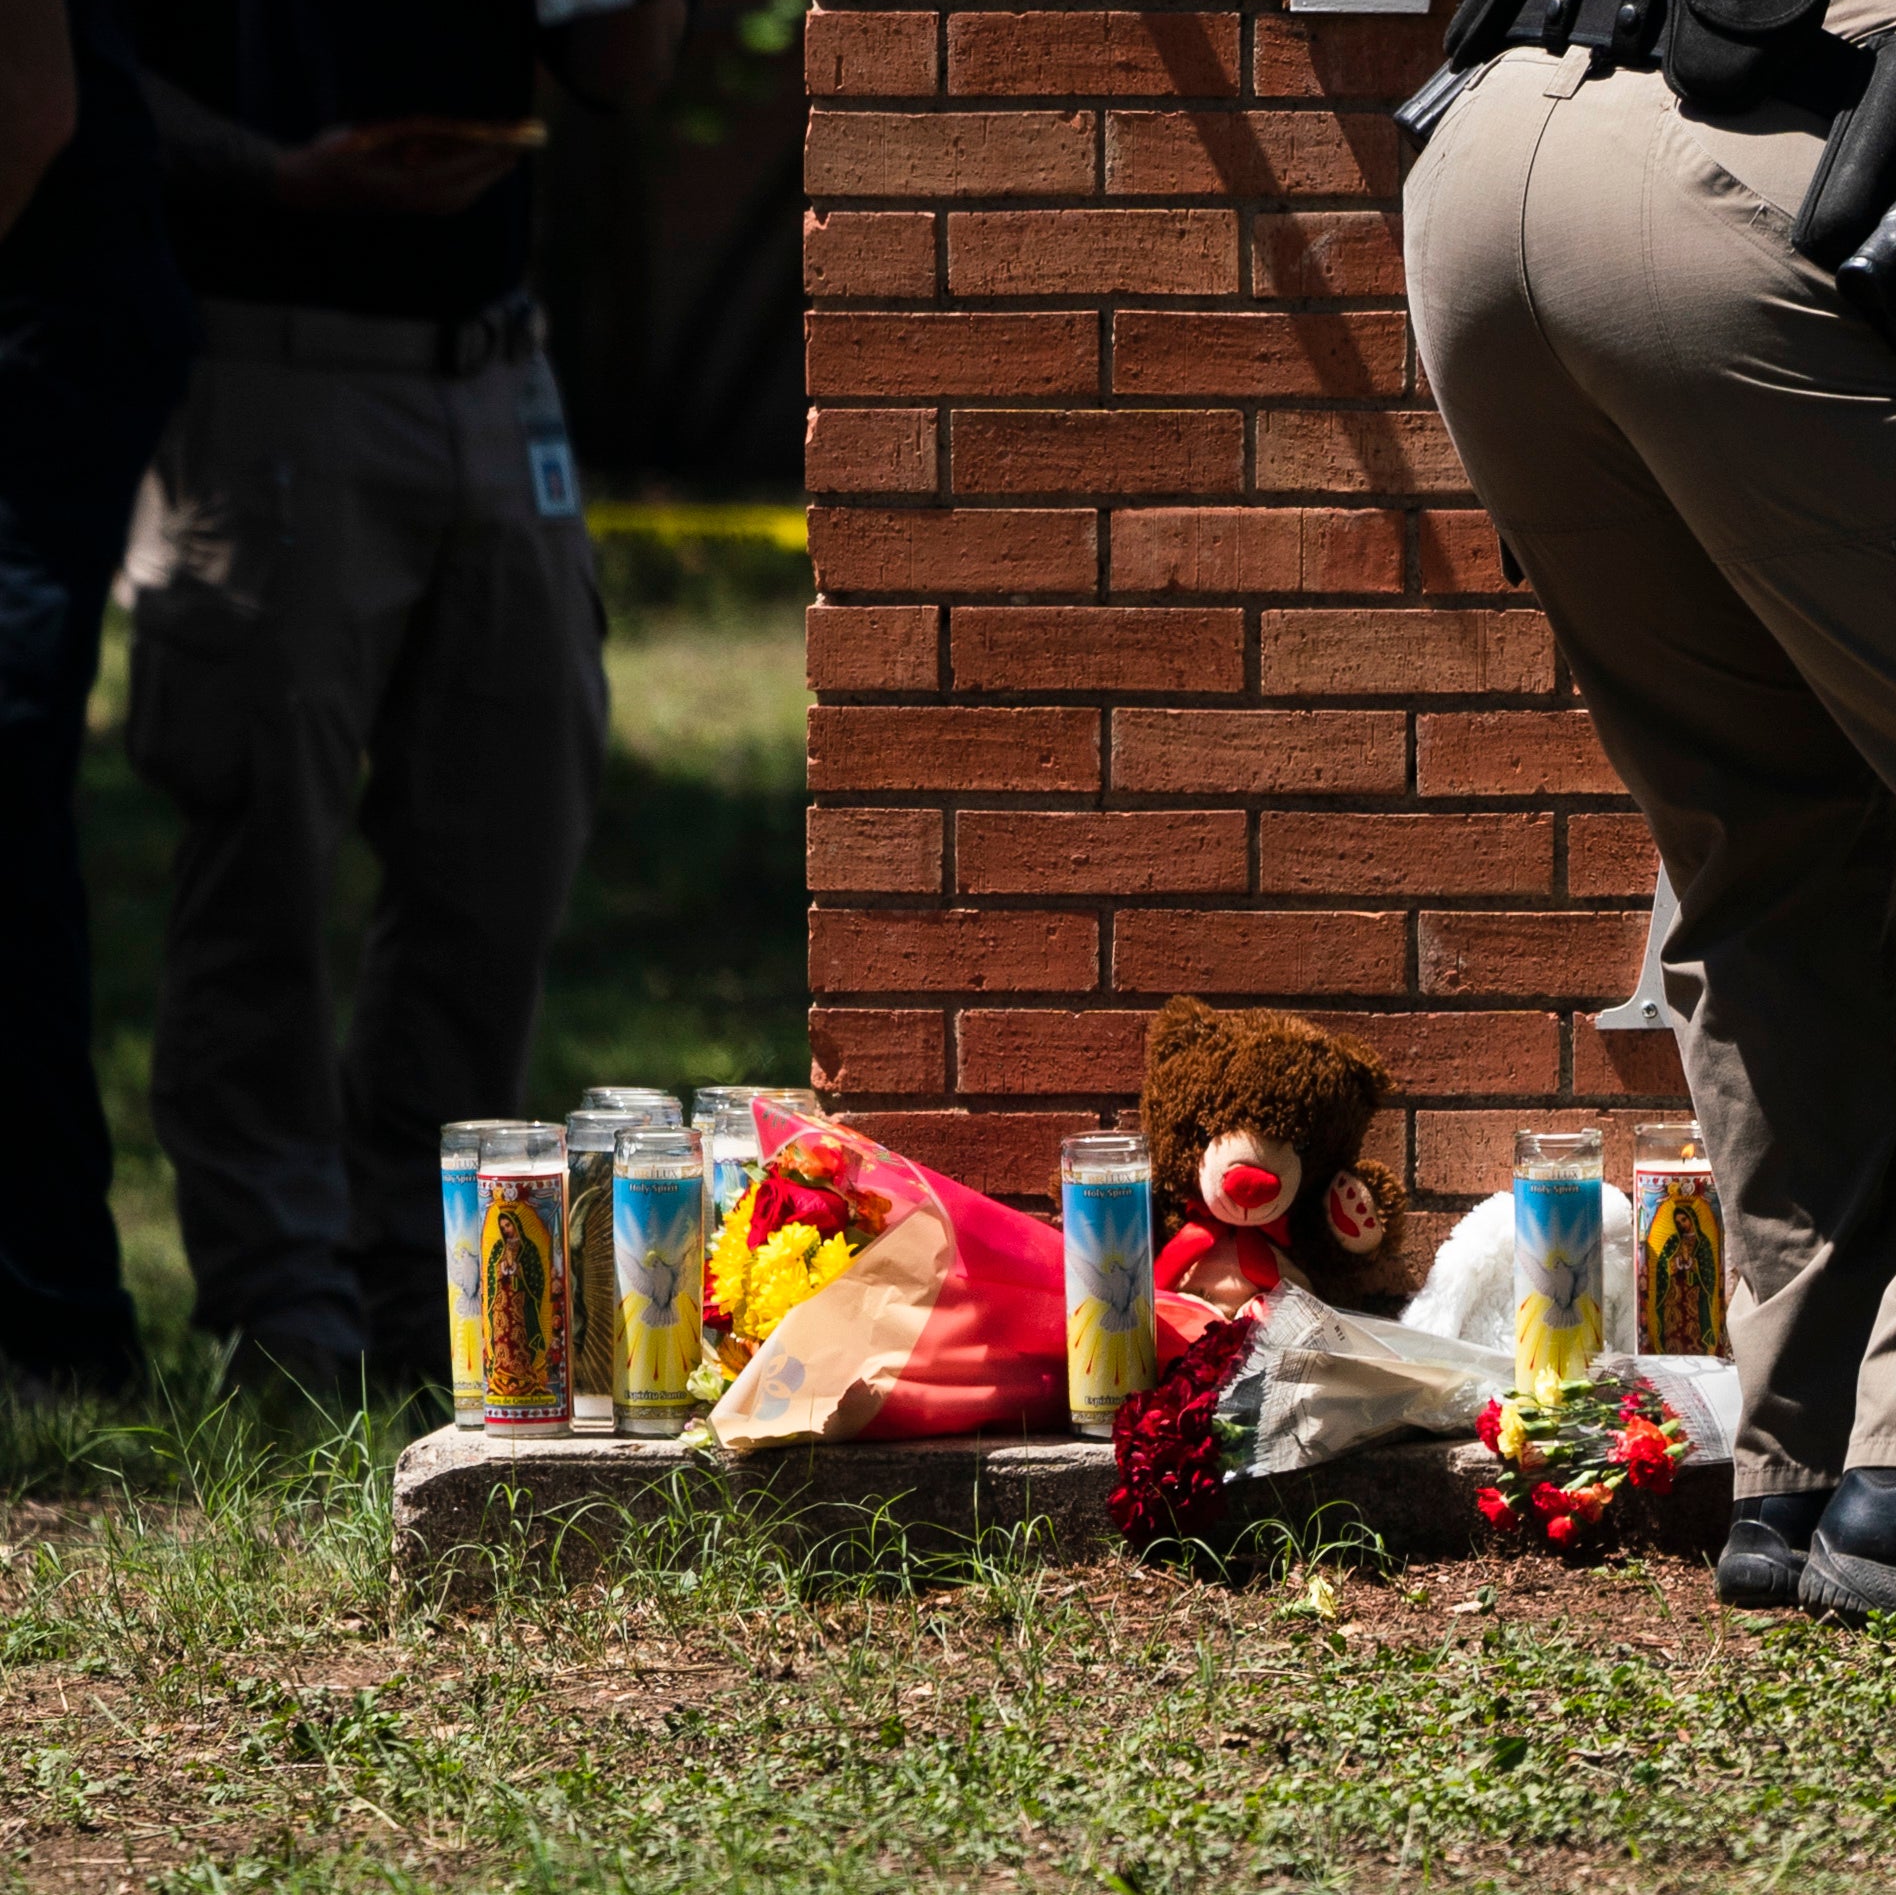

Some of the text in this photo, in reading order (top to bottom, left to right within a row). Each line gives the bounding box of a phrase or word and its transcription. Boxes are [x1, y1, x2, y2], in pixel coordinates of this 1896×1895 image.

[629, 1183, 679, 1194] Holy Spirit
[1083, 1188, 1133, 1199] Holy Spirit
